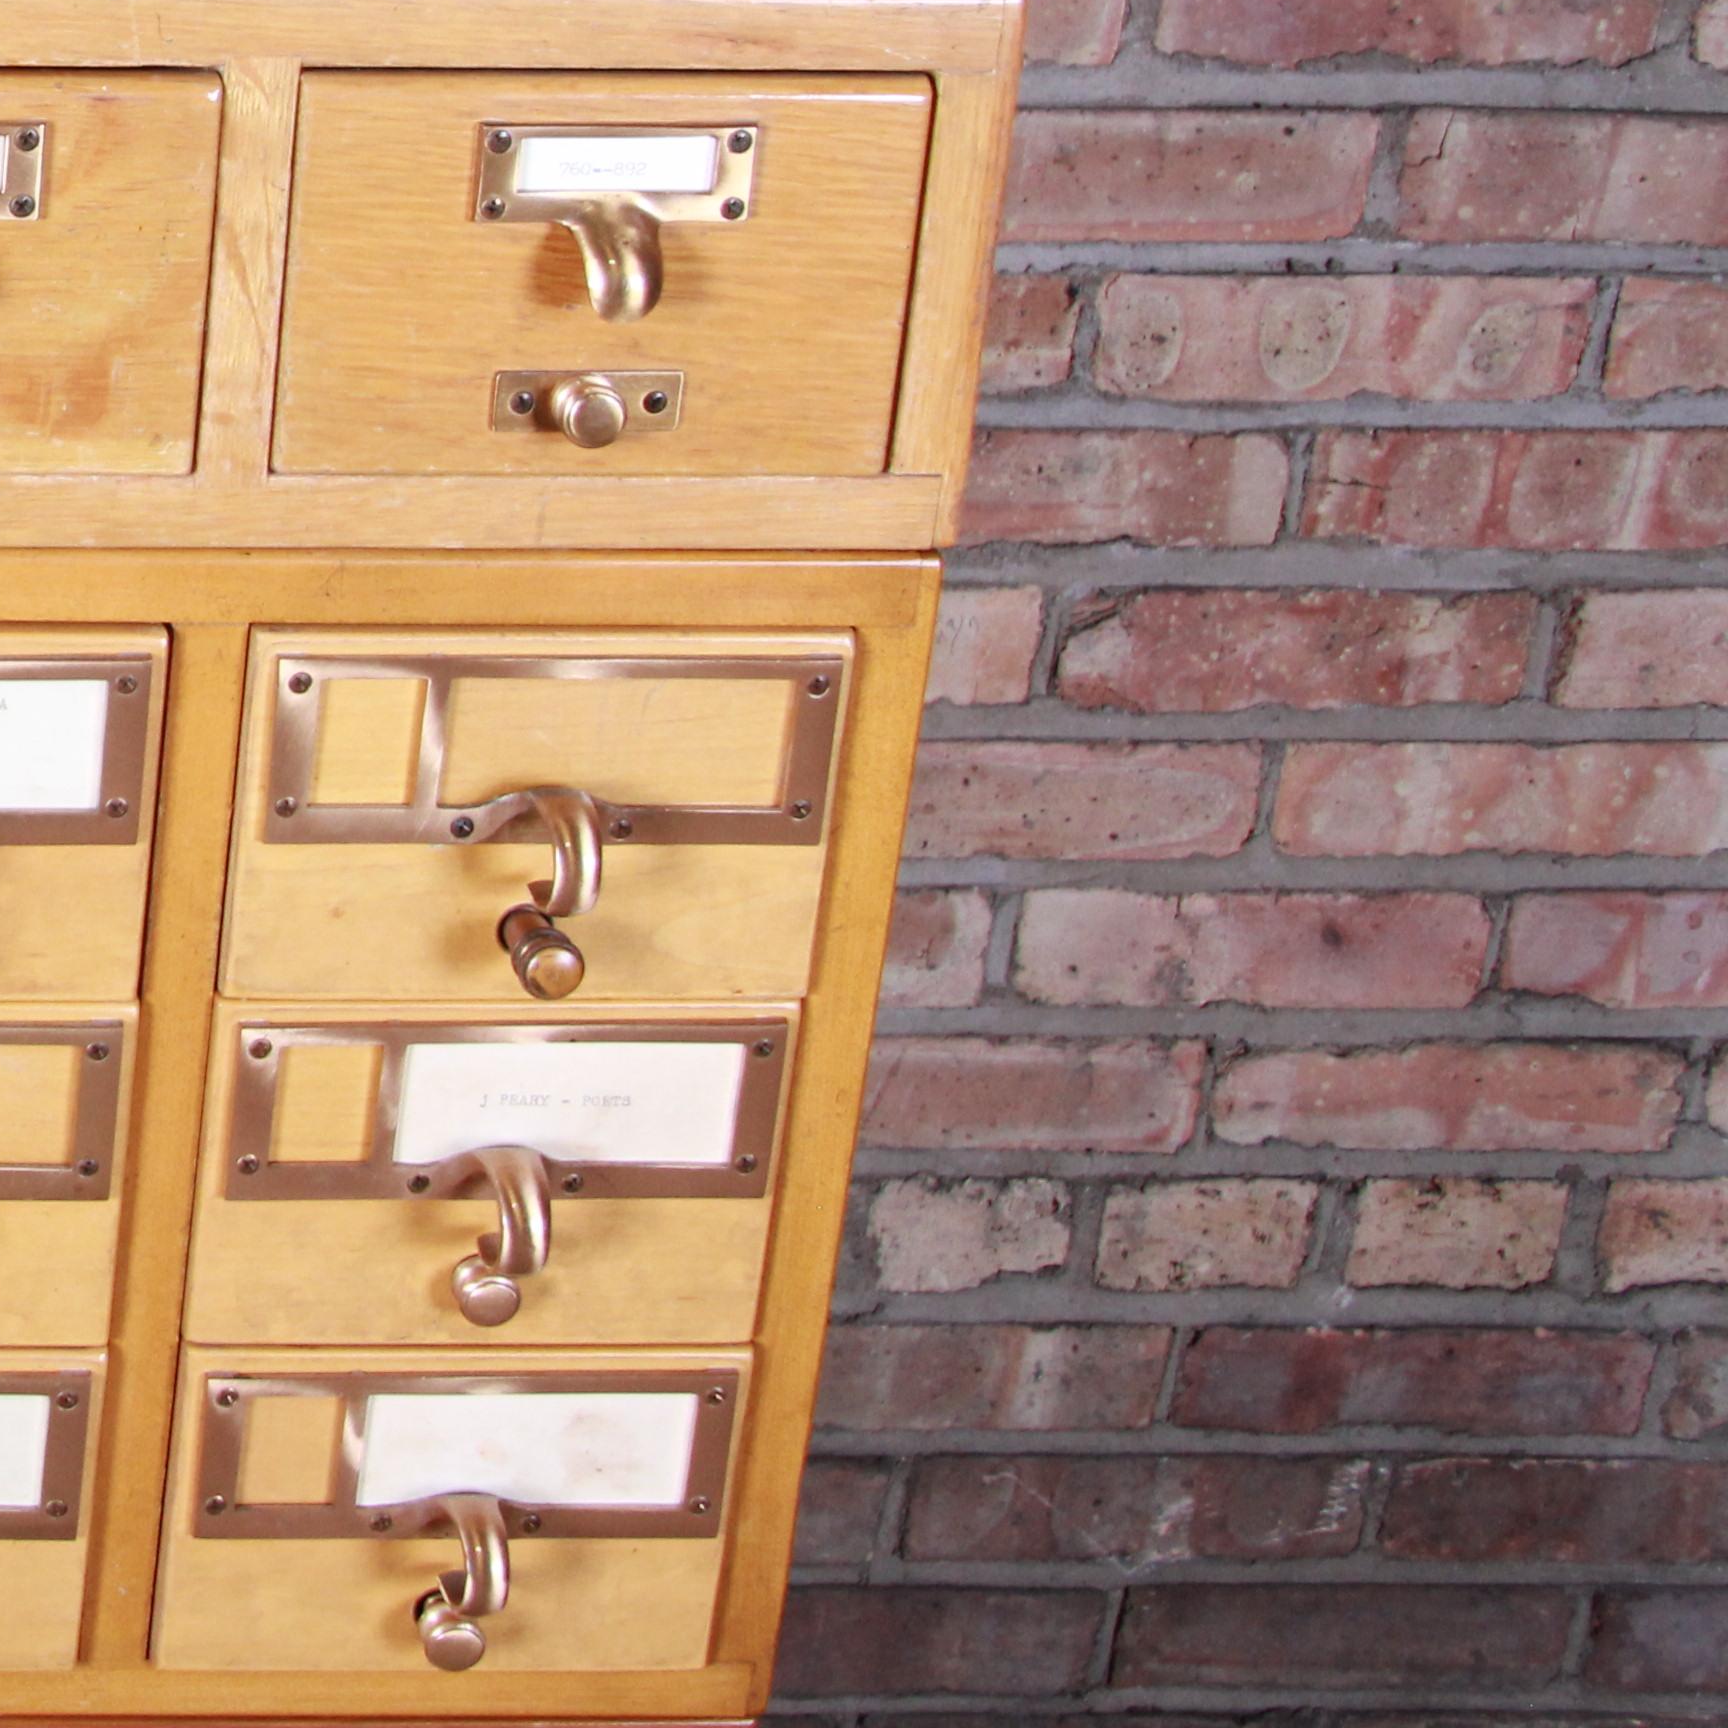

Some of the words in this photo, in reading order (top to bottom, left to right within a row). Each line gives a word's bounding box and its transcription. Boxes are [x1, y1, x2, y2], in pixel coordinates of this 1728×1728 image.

[559, 162, 647, 176] 760--892
[499, 1094, 549, 1107] PEARY
[581, 1094, 631, 1107] POETS
